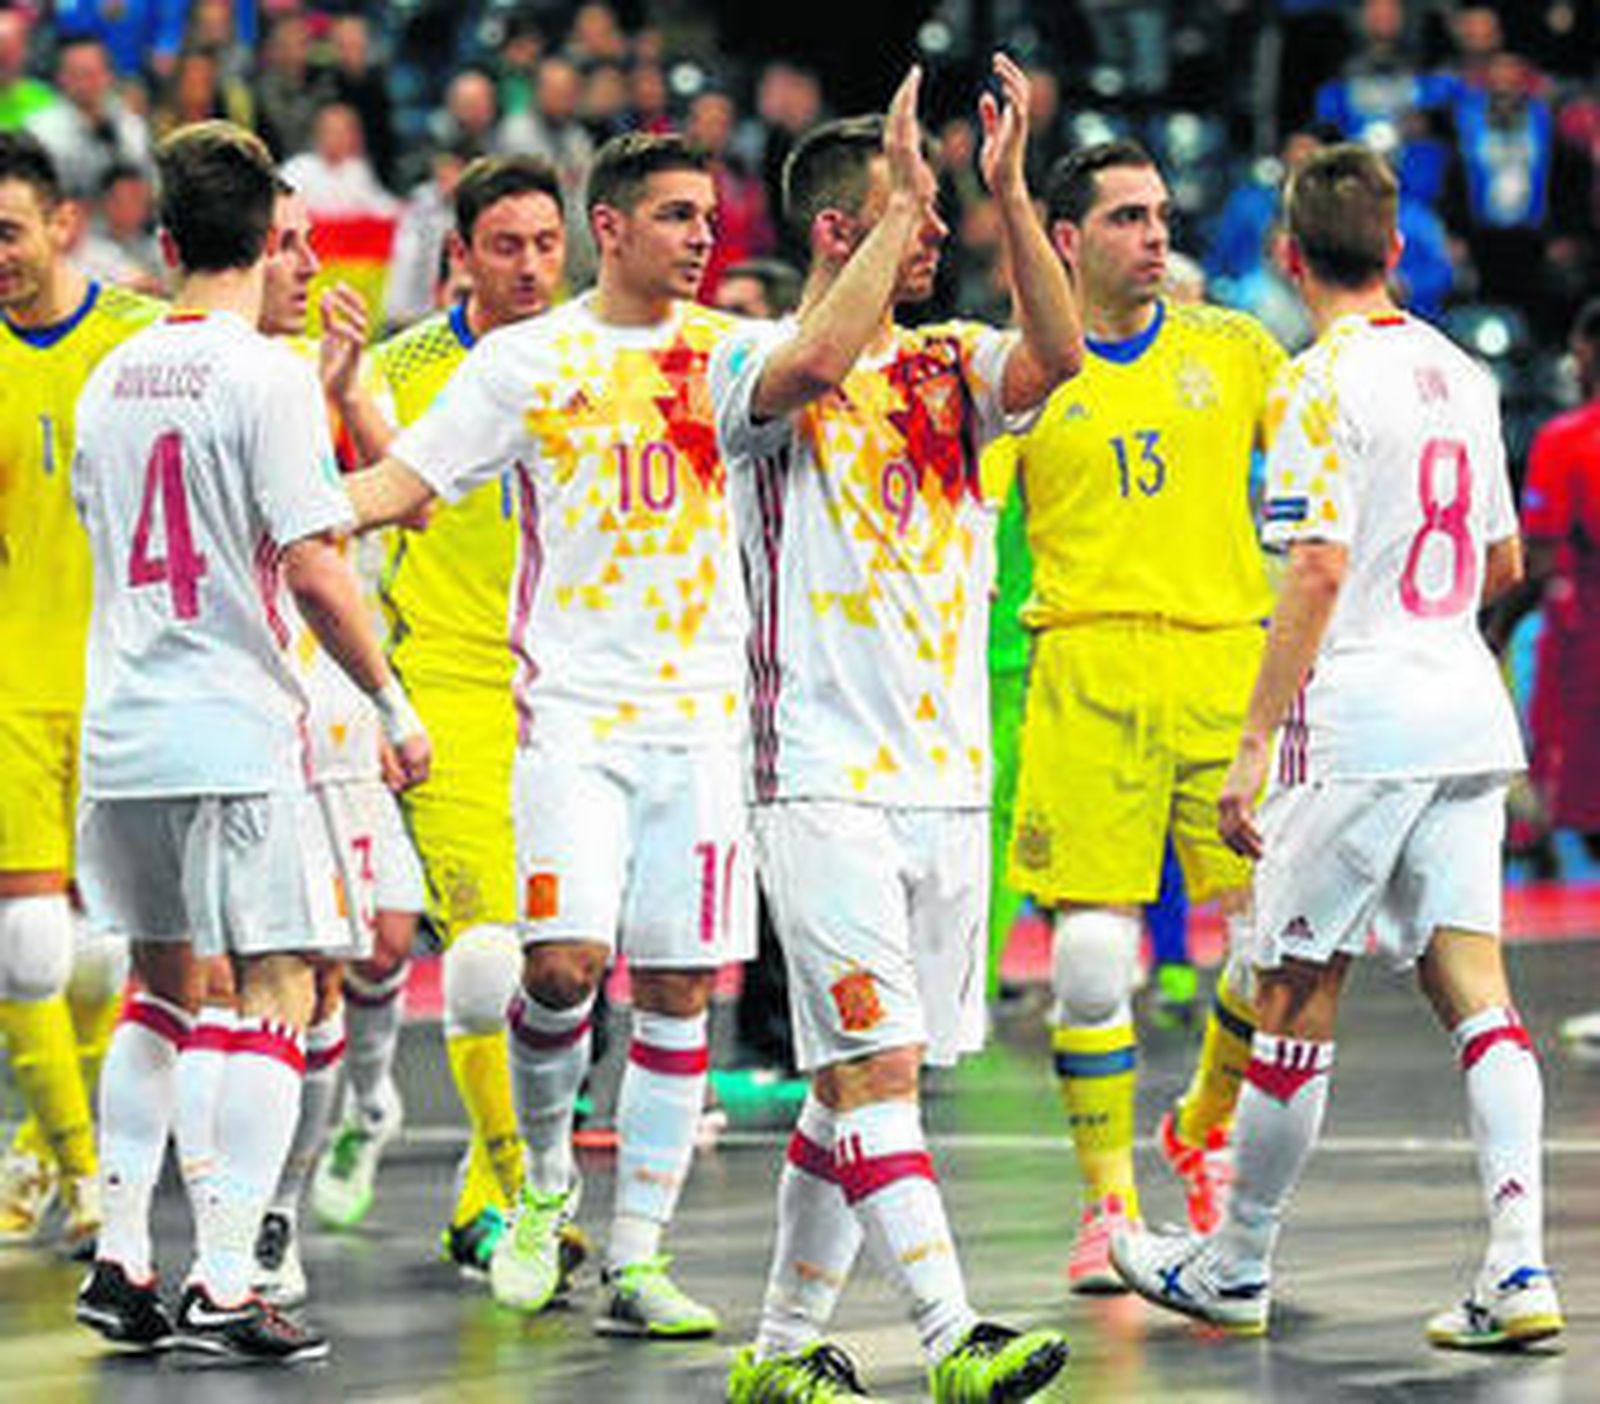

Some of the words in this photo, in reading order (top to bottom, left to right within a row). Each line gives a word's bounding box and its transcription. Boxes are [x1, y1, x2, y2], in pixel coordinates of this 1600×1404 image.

[614, 441, 677, 513] 10
[880, 461, 916, 537] 9
[1109, 430, 1166, 498] 13
[128, 430, 208, 620] 4
[1400, 437, 1478, 620] 8
